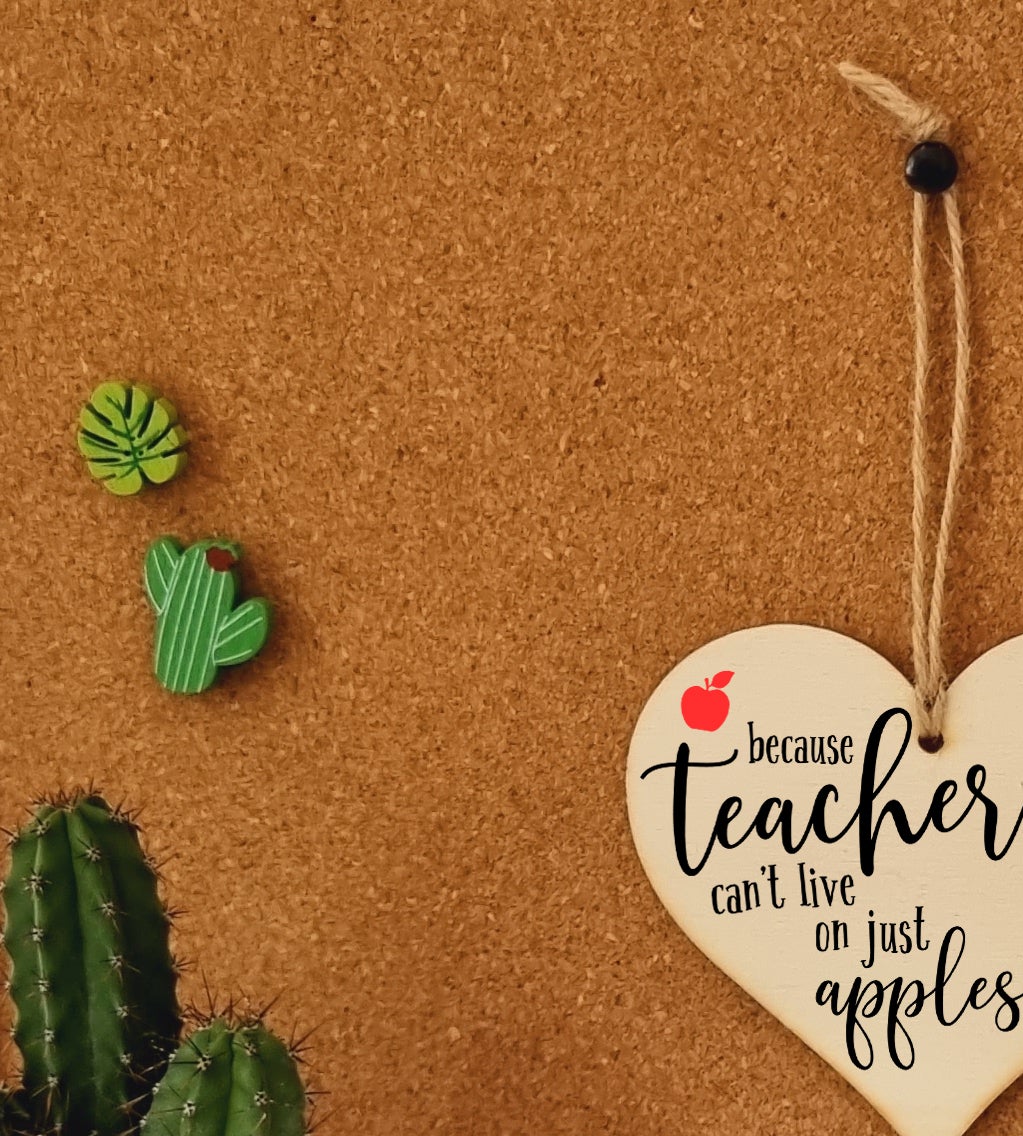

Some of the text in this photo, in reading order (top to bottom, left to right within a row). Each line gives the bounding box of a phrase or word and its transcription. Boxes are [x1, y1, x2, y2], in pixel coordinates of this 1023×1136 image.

[747, 721, 854, 765] because
[711, 861, 856, 915] can't live
[815, 905, 931, 969] on just
